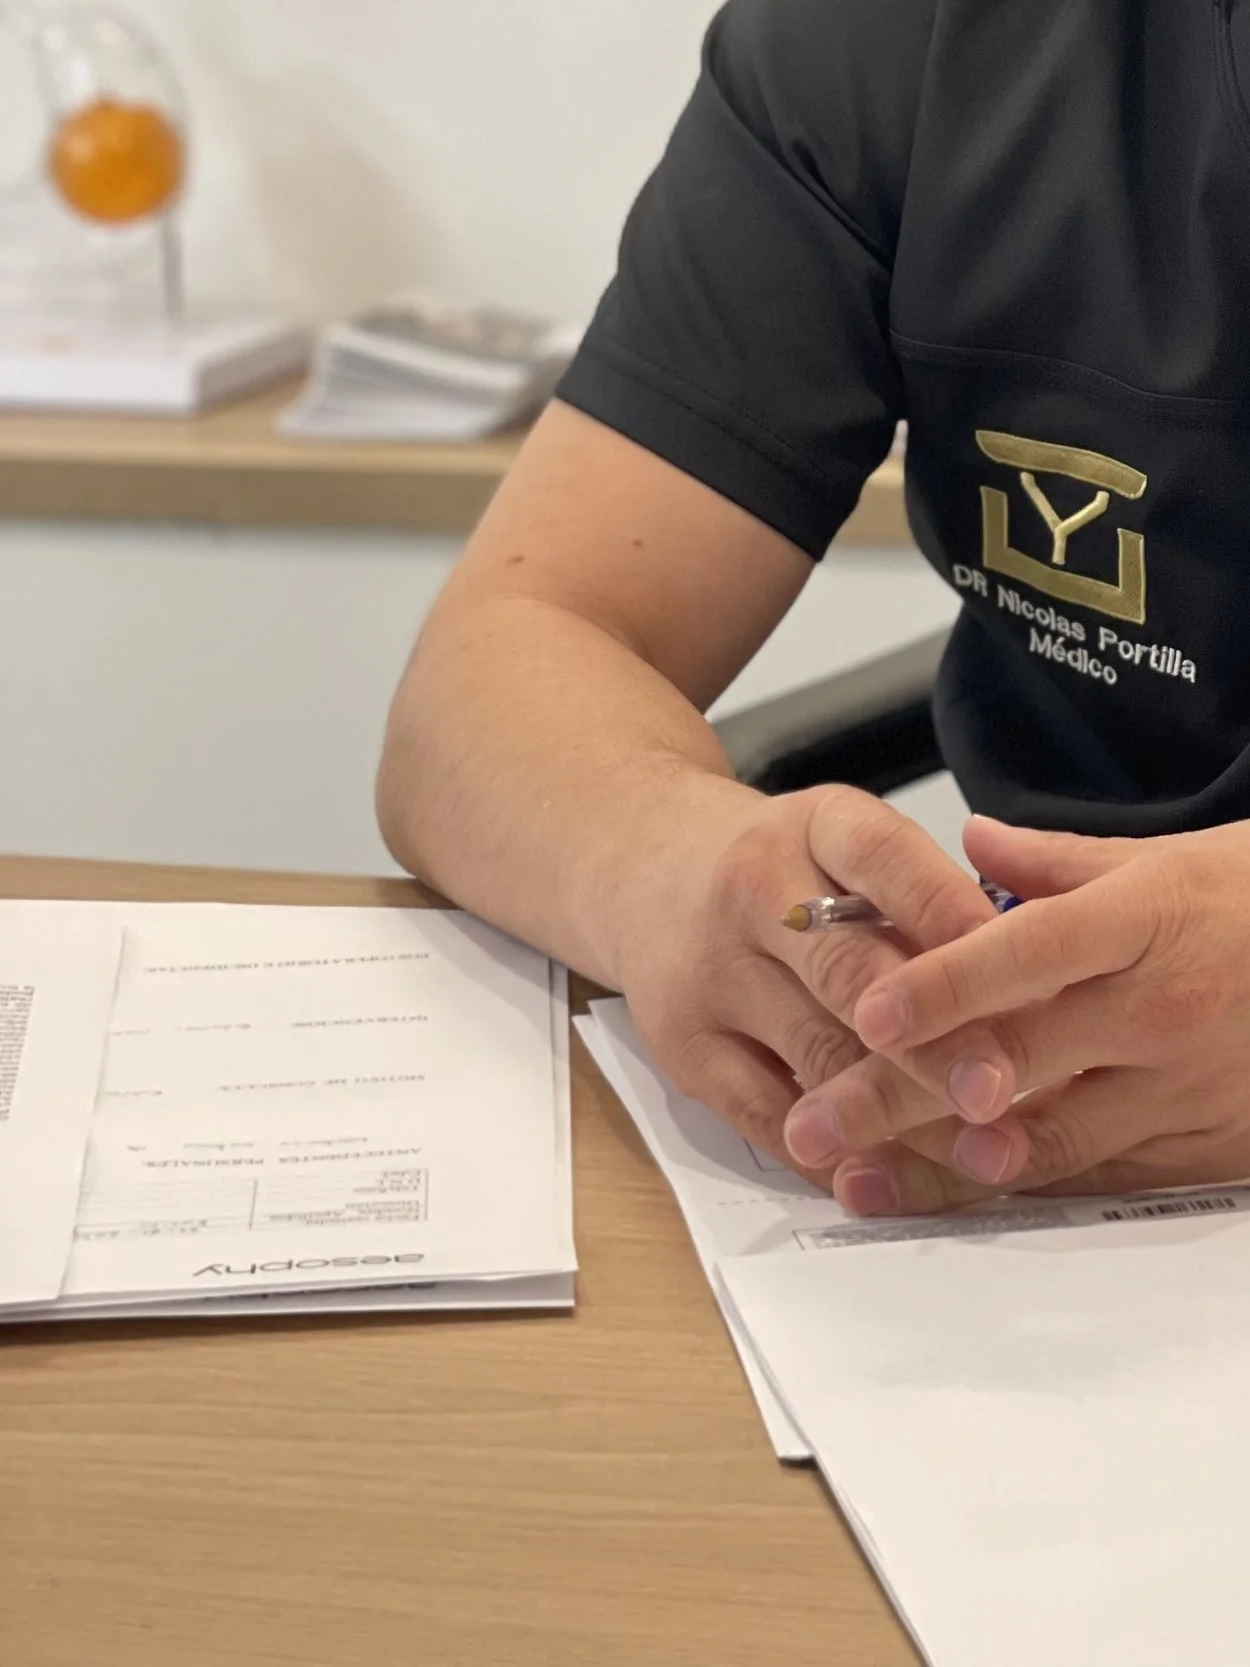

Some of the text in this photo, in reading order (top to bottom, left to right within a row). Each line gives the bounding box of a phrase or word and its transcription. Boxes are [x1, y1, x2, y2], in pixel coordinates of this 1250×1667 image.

[953, 564, 988, 597] DR
[1098, 627, 1197, 683] Portilla
[1029, 628, 1118, 685] Médico
[191, 1253, 425, 1277] aesophy
